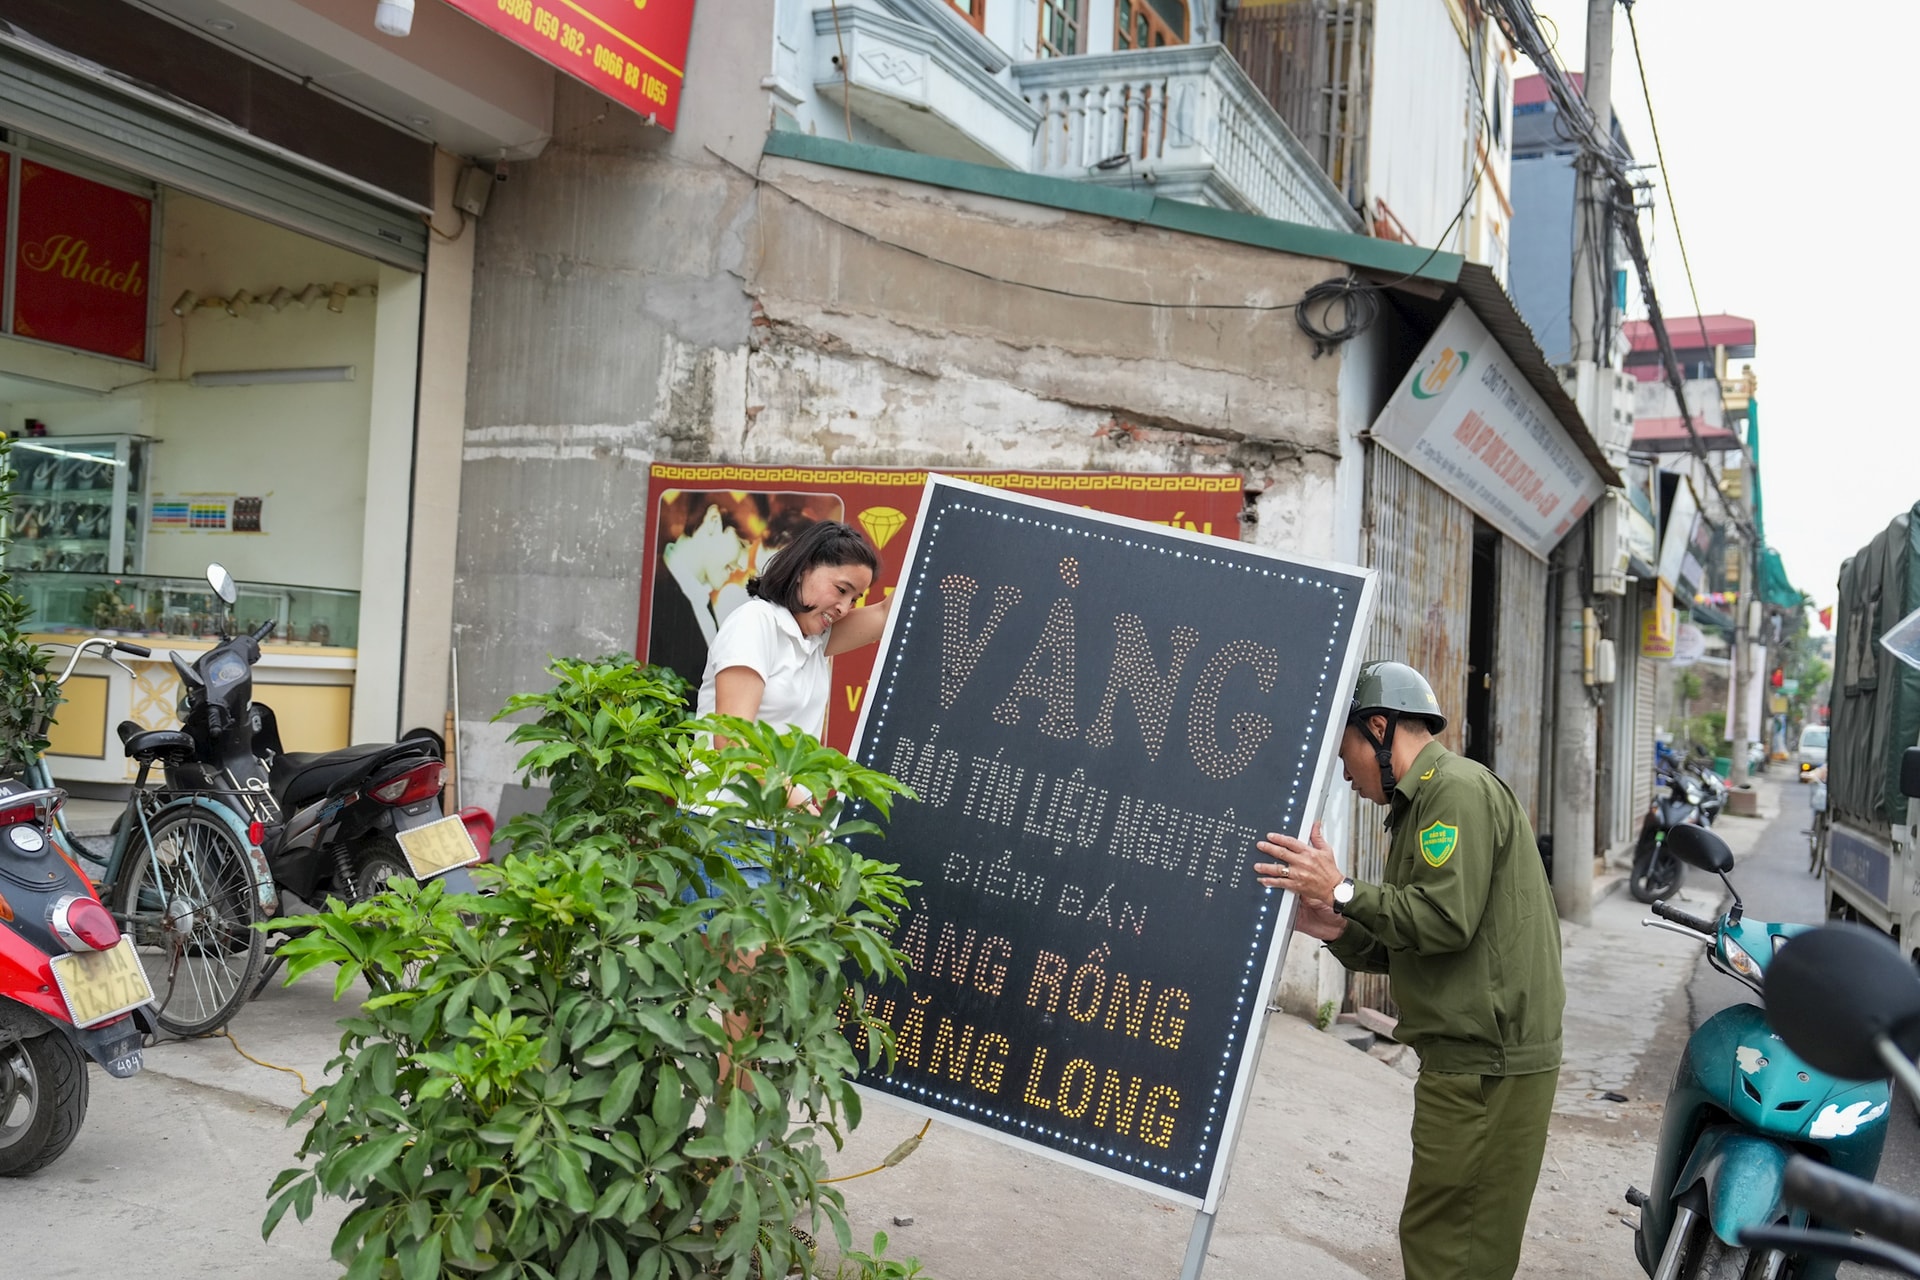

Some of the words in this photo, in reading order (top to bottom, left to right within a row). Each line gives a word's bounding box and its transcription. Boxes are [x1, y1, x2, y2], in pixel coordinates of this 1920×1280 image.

[534, 6, 560, 41] 059
[560, 22, 586, 57] 362
[593, 43, 624, 80] 0966
[624, 61, 640, 90] 88
[641, 71, 669, 107] 1055
[21, 234, 146, 297] Khách
[939, 556, 1280, 781] VÀNG
[962, 746, 1025, 828] TÍN
[1057, 883, 1148, 935] BÁN
[1026, 941, 1191, 1052] RỒNG
[1022, 1045, 1182, 1149] LONG
